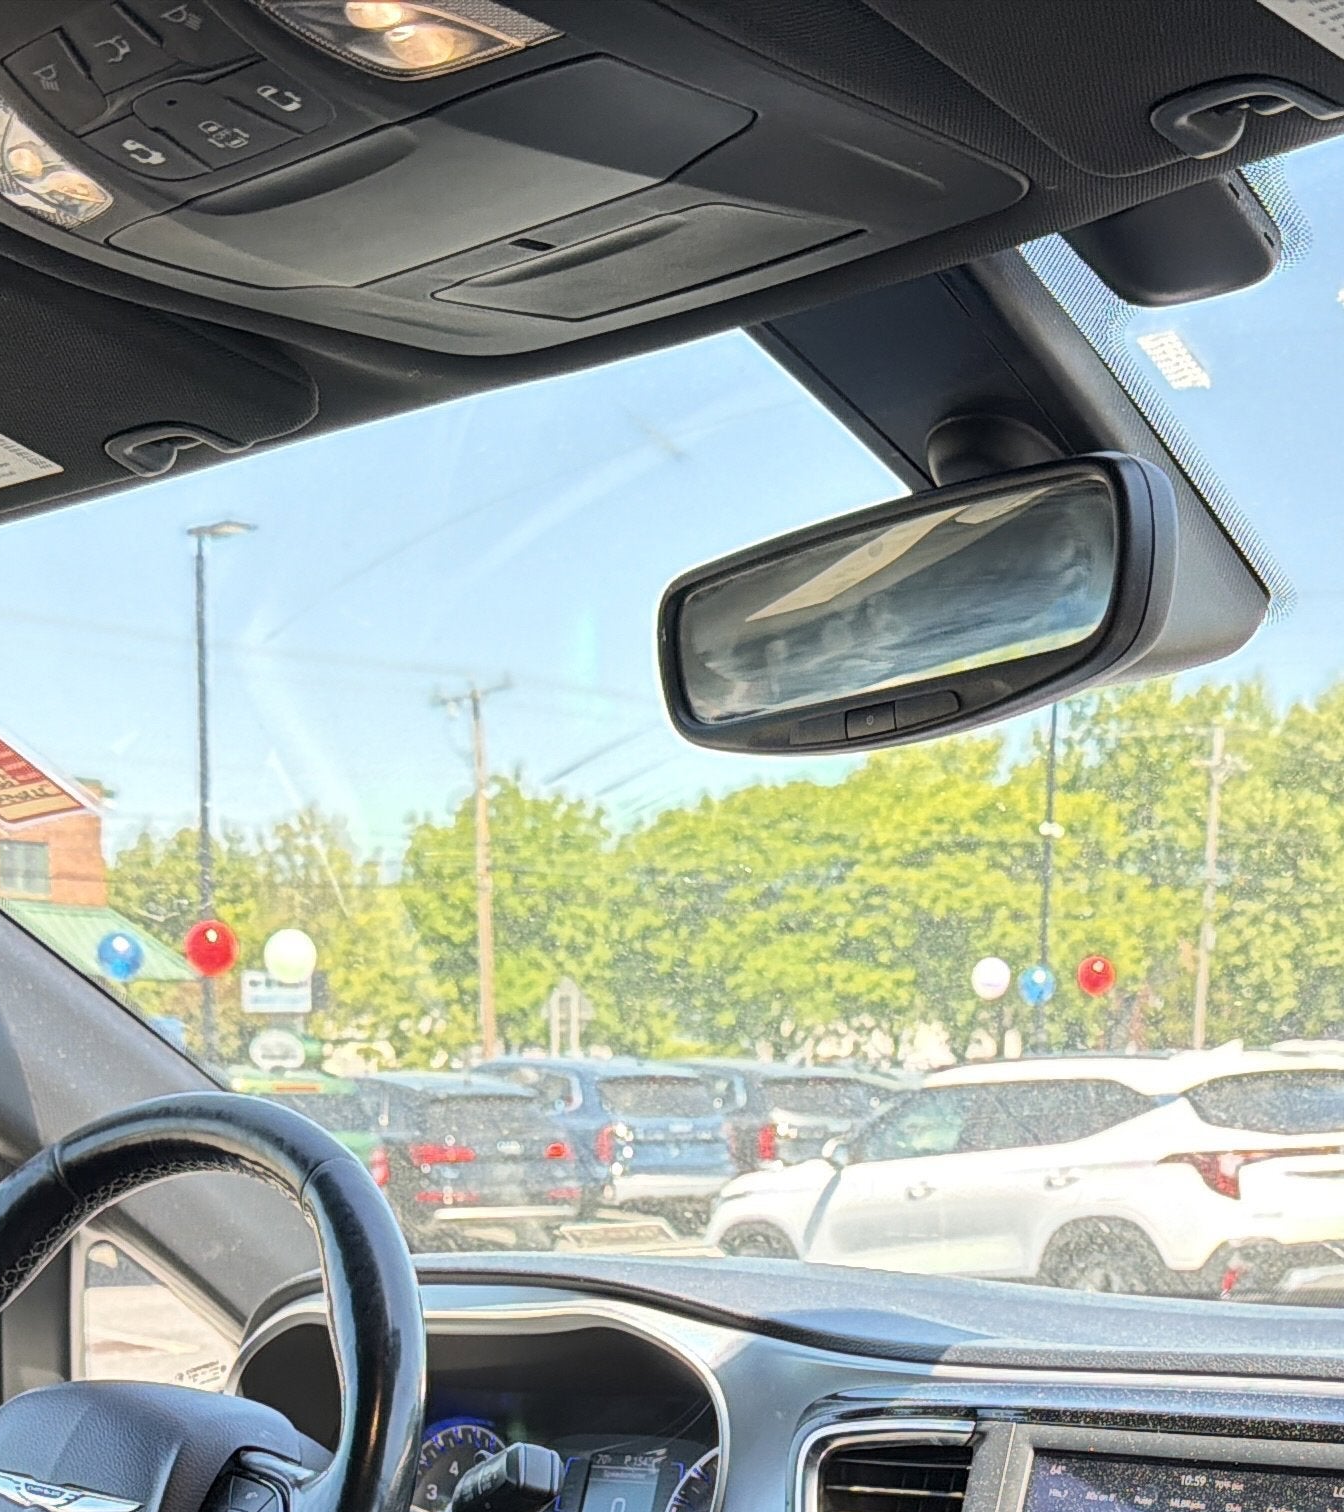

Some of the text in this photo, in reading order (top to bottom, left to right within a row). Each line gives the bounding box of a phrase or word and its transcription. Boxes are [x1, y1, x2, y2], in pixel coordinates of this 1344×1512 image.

[448, 1461, 459, 1477] 4
[1180, 1474, 1207, 1488] 10:59
[426, 1484, 438, 1500] 3
